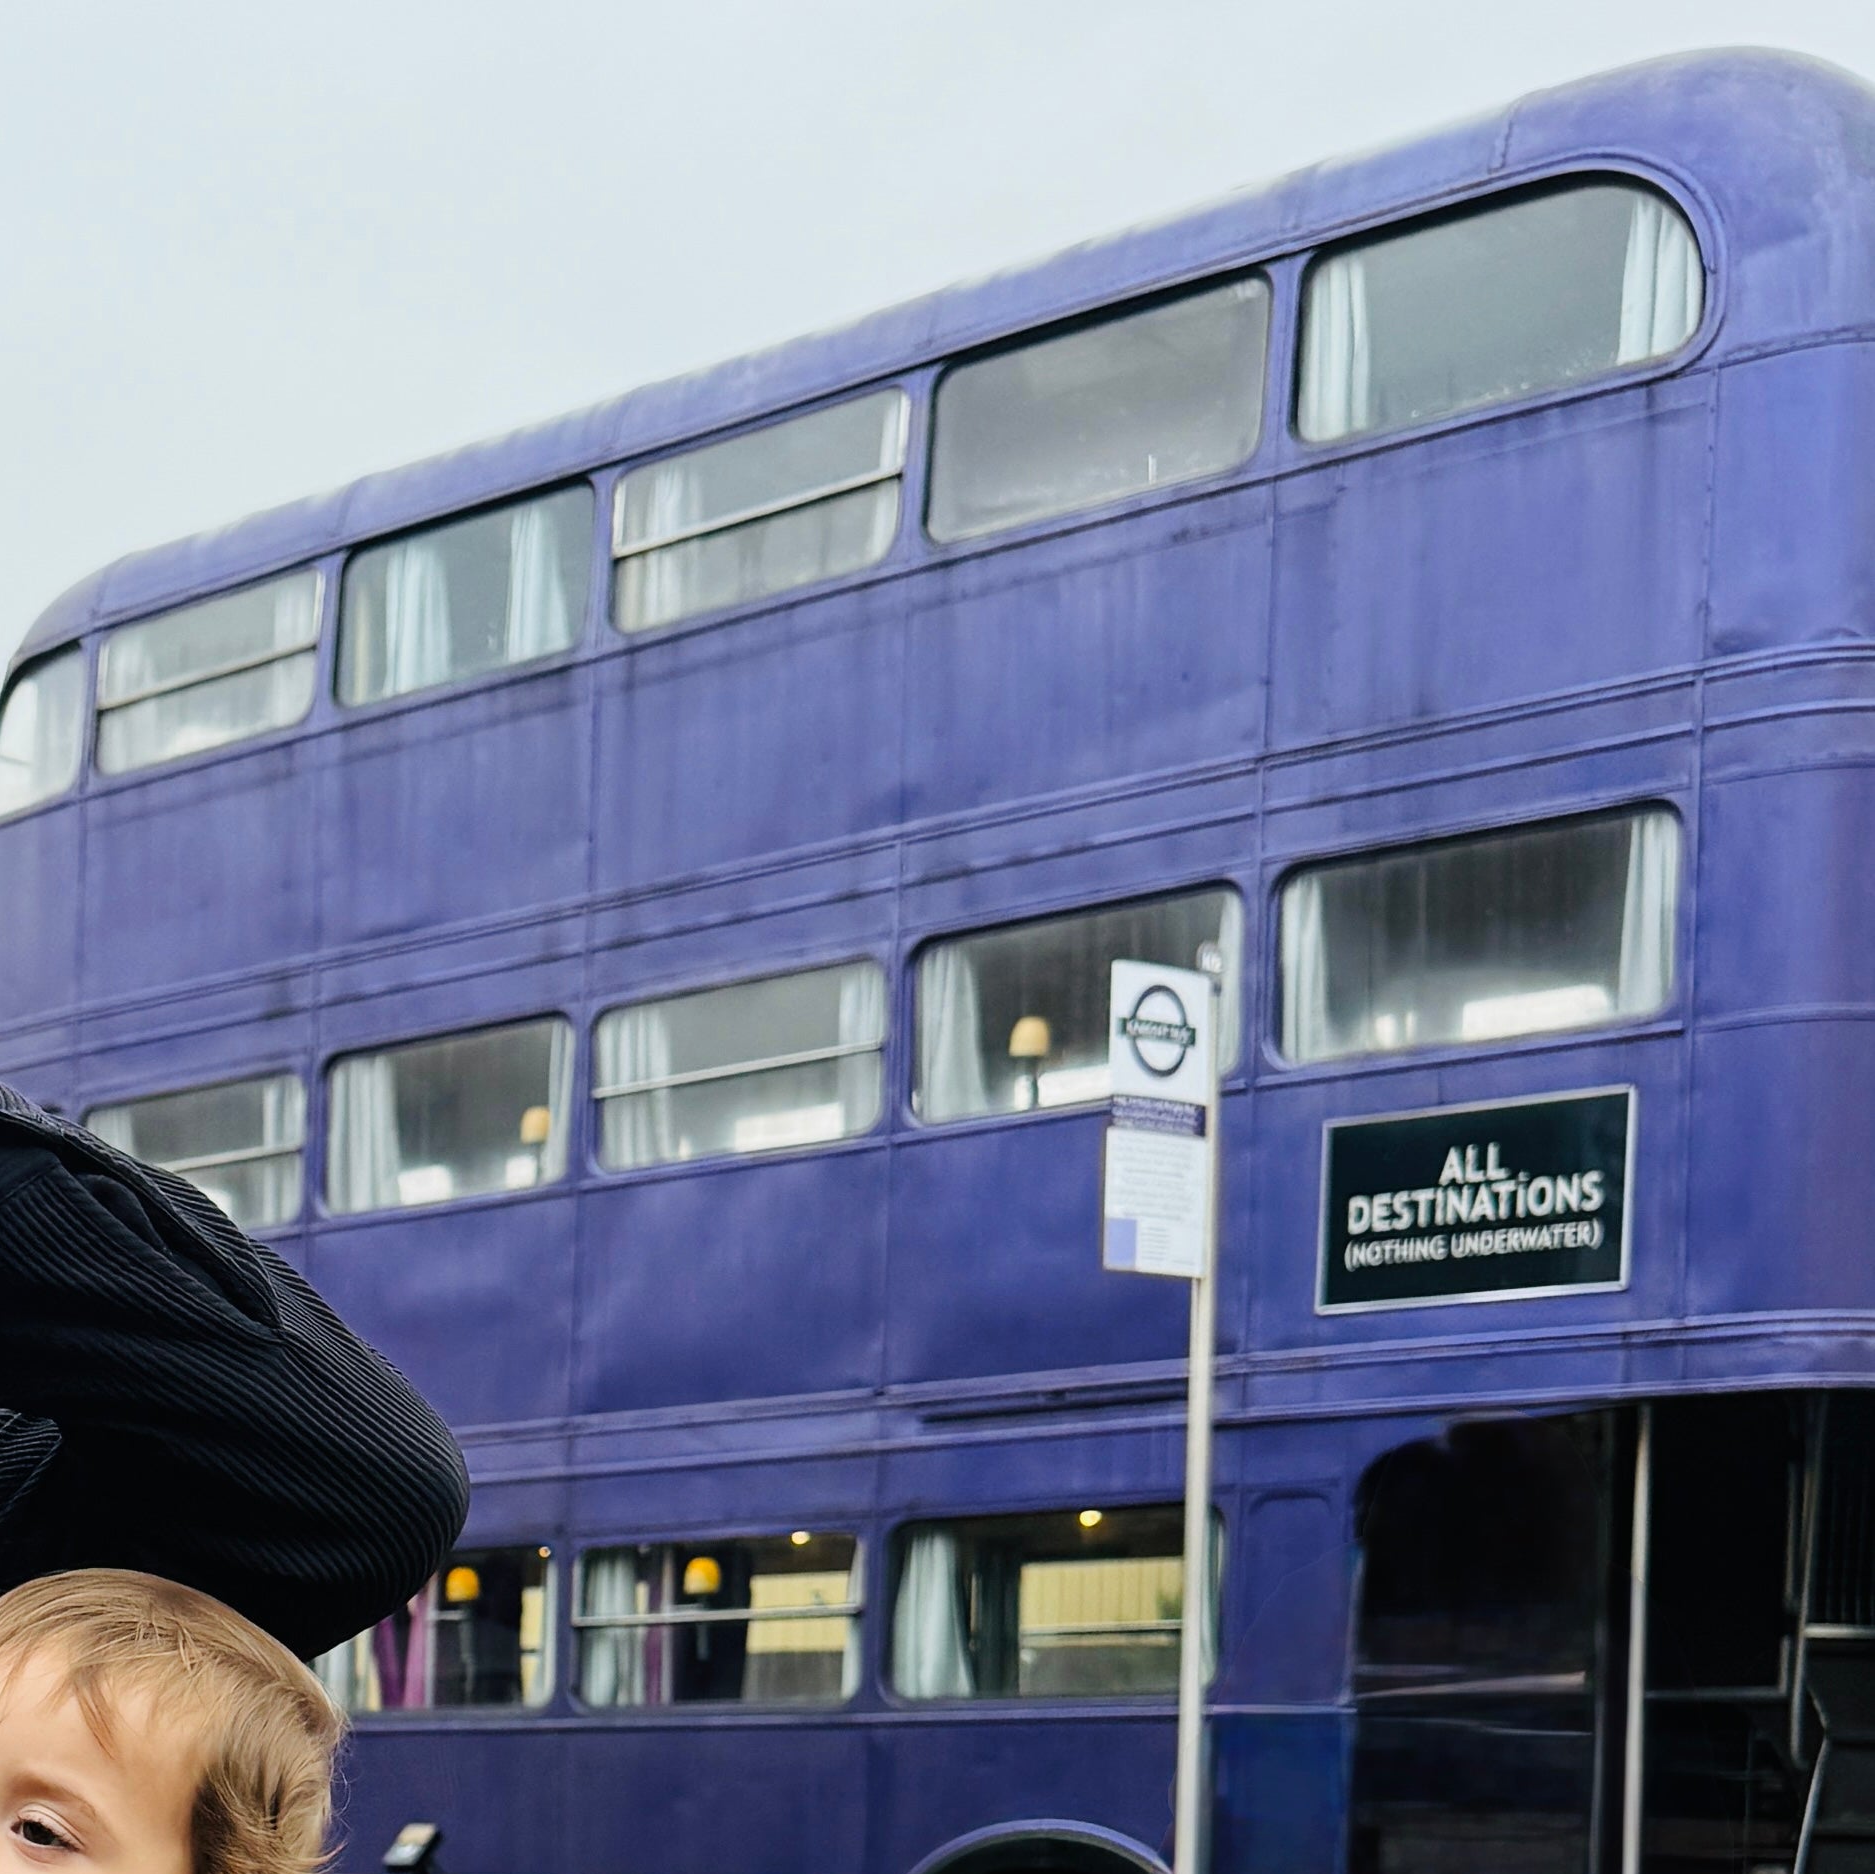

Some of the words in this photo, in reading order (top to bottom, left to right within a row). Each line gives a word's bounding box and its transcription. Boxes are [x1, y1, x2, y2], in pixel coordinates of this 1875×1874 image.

[1438, 1141, 1511, 1186] ALL
[1344, 1234, 1449, 1273] (NOTHING
[1451, 1217, 1605, 1259] UNDERWATER)
